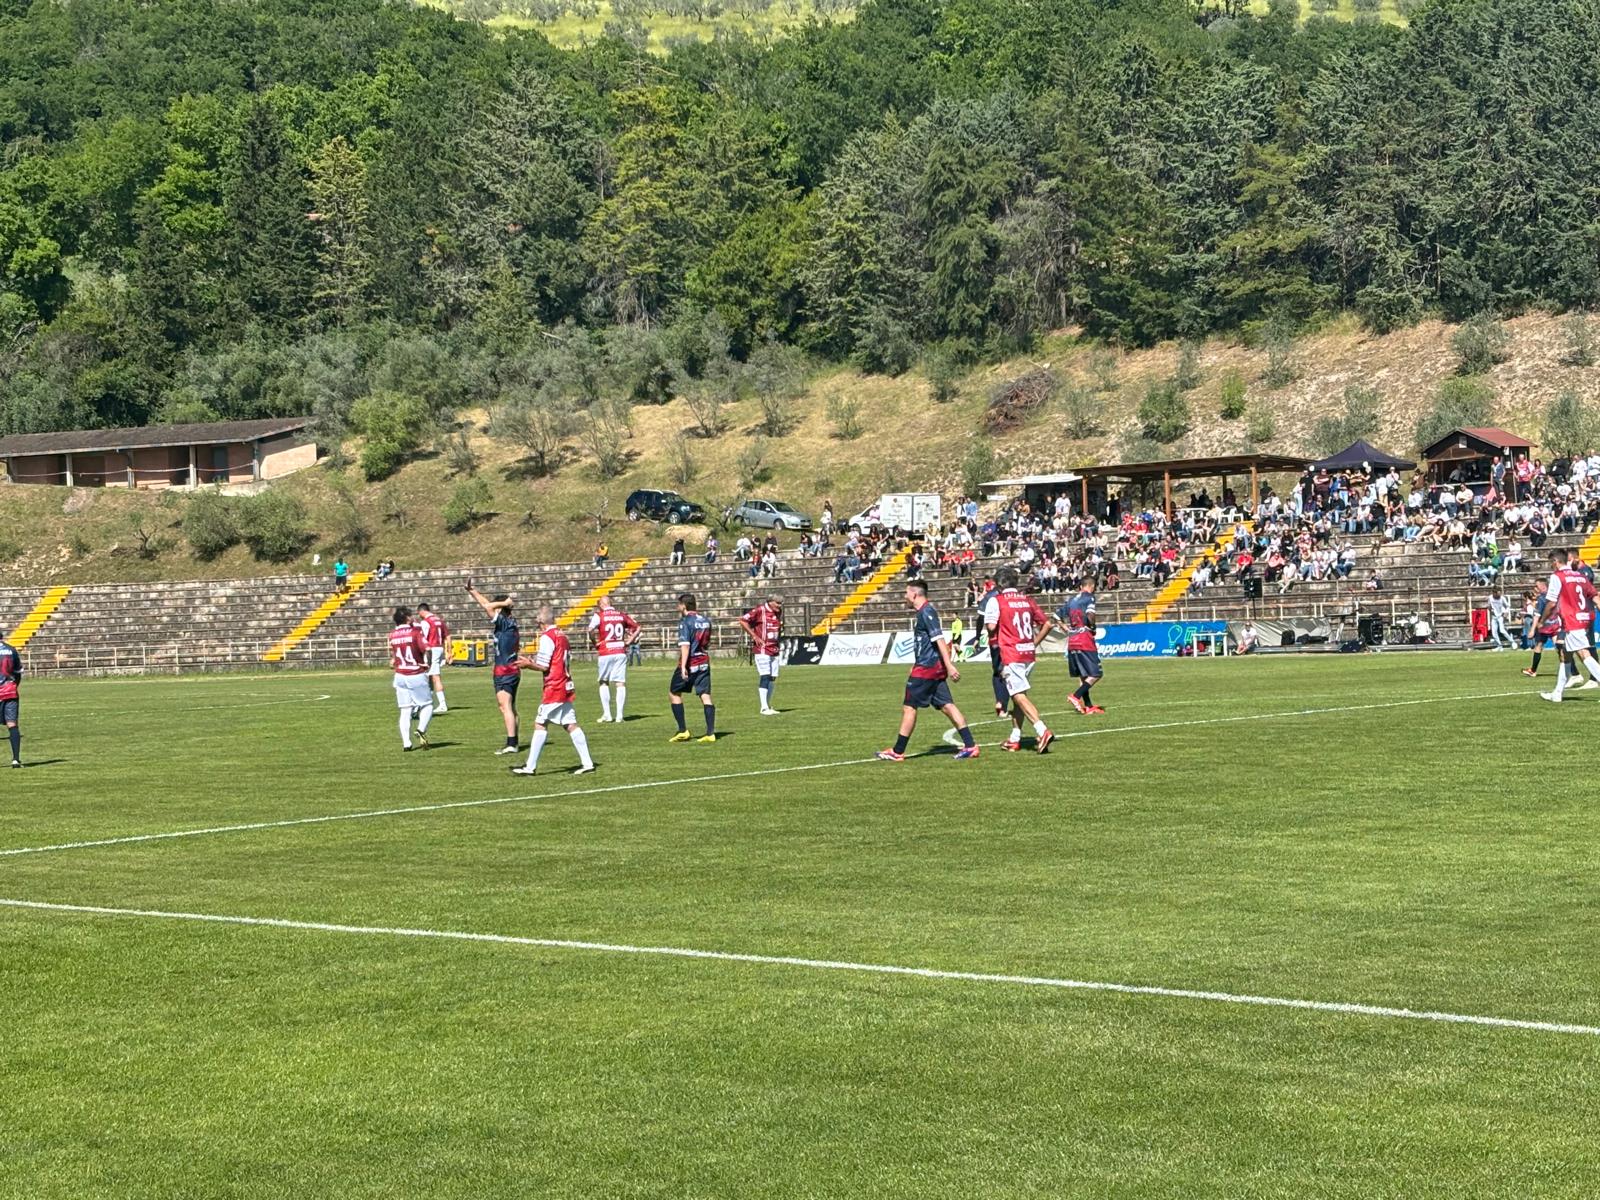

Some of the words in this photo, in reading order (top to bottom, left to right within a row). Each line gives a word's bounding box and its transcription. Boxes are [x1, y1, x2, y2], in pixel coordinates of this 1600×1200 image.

[1575, 585, 1586, 610] 3
[605, 623, 624, 641] 29
[1013, 611, 1033, 639] 18
[396, 646, 418, 666] 14
